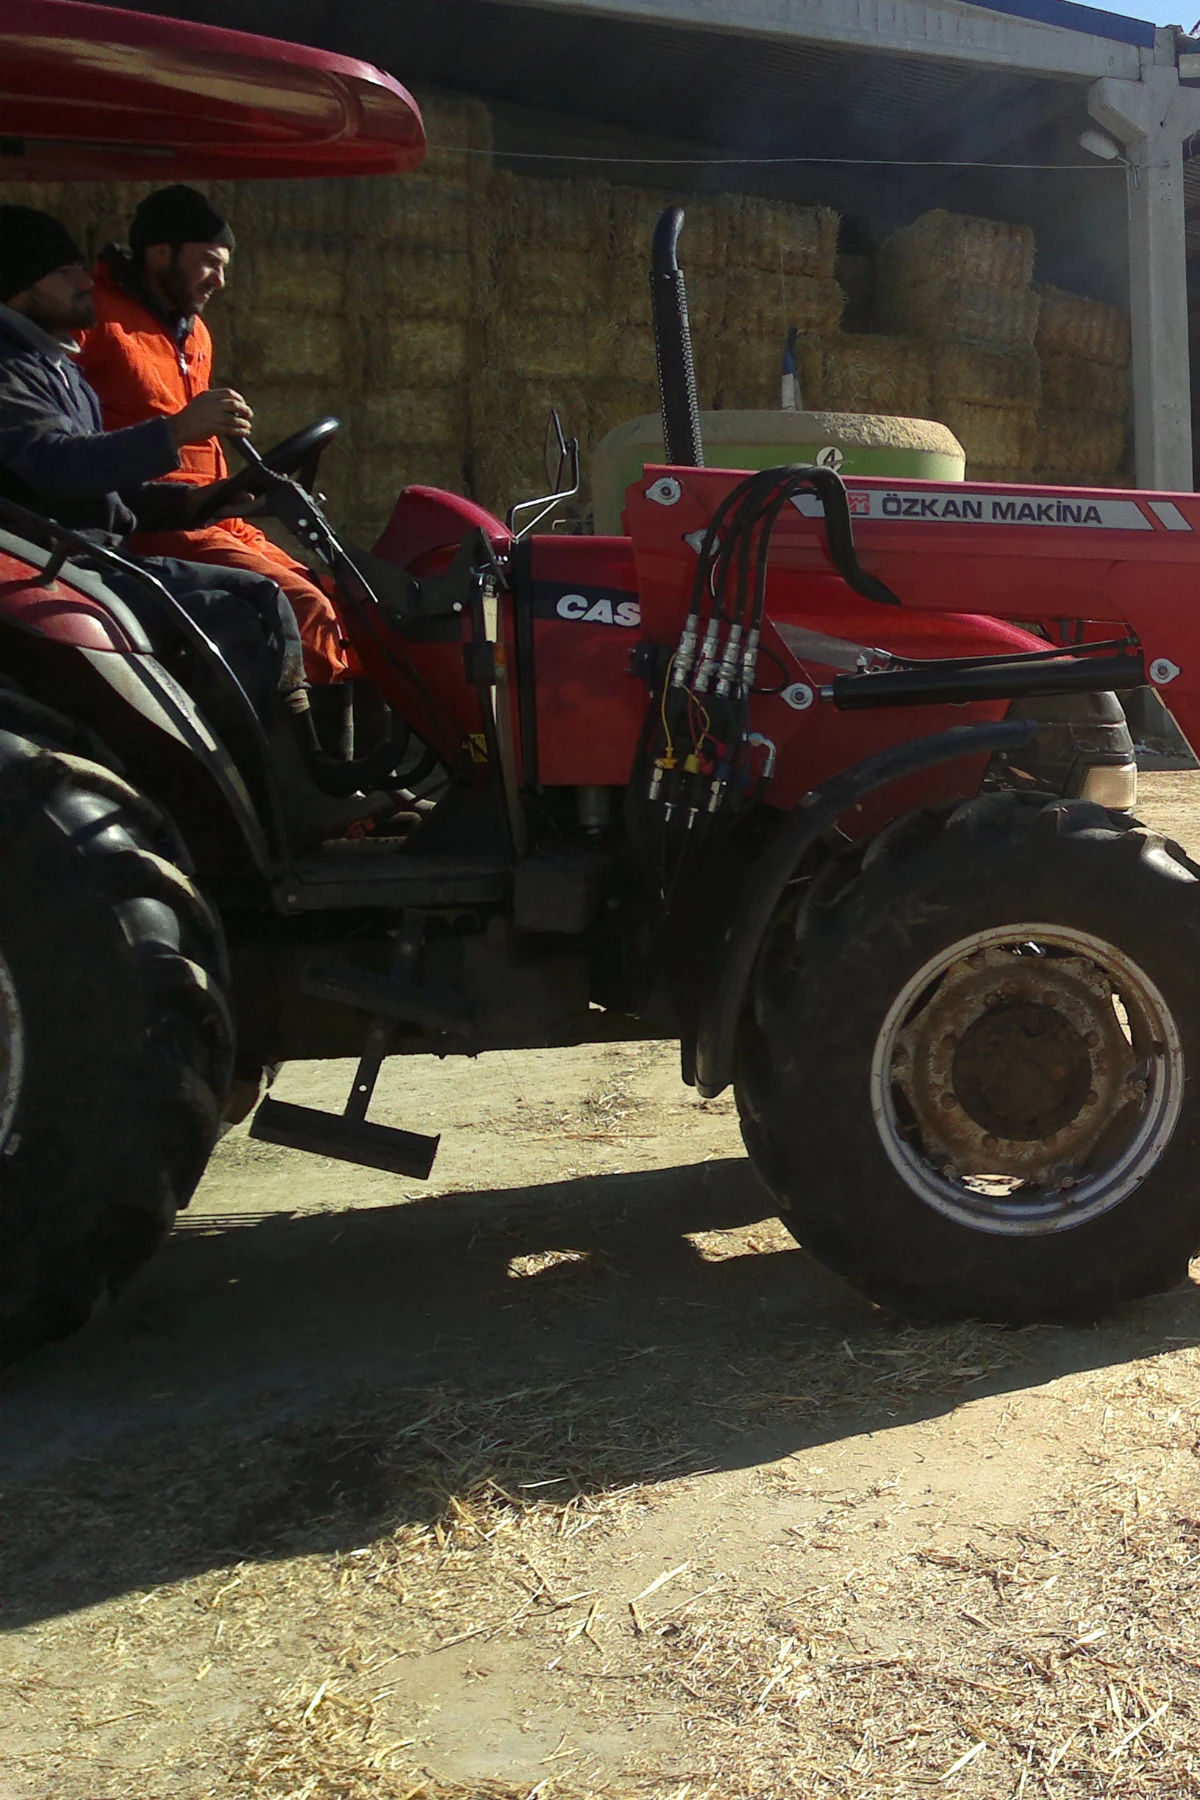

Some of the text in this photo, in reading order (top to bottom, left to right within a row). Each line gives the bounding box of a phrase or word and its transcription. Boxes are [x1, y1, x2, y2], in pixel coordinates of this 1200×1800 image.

[882, 493, 1103, 525] ÖZKAN MAKİNA
[556, 594, 641, 627] CAS
